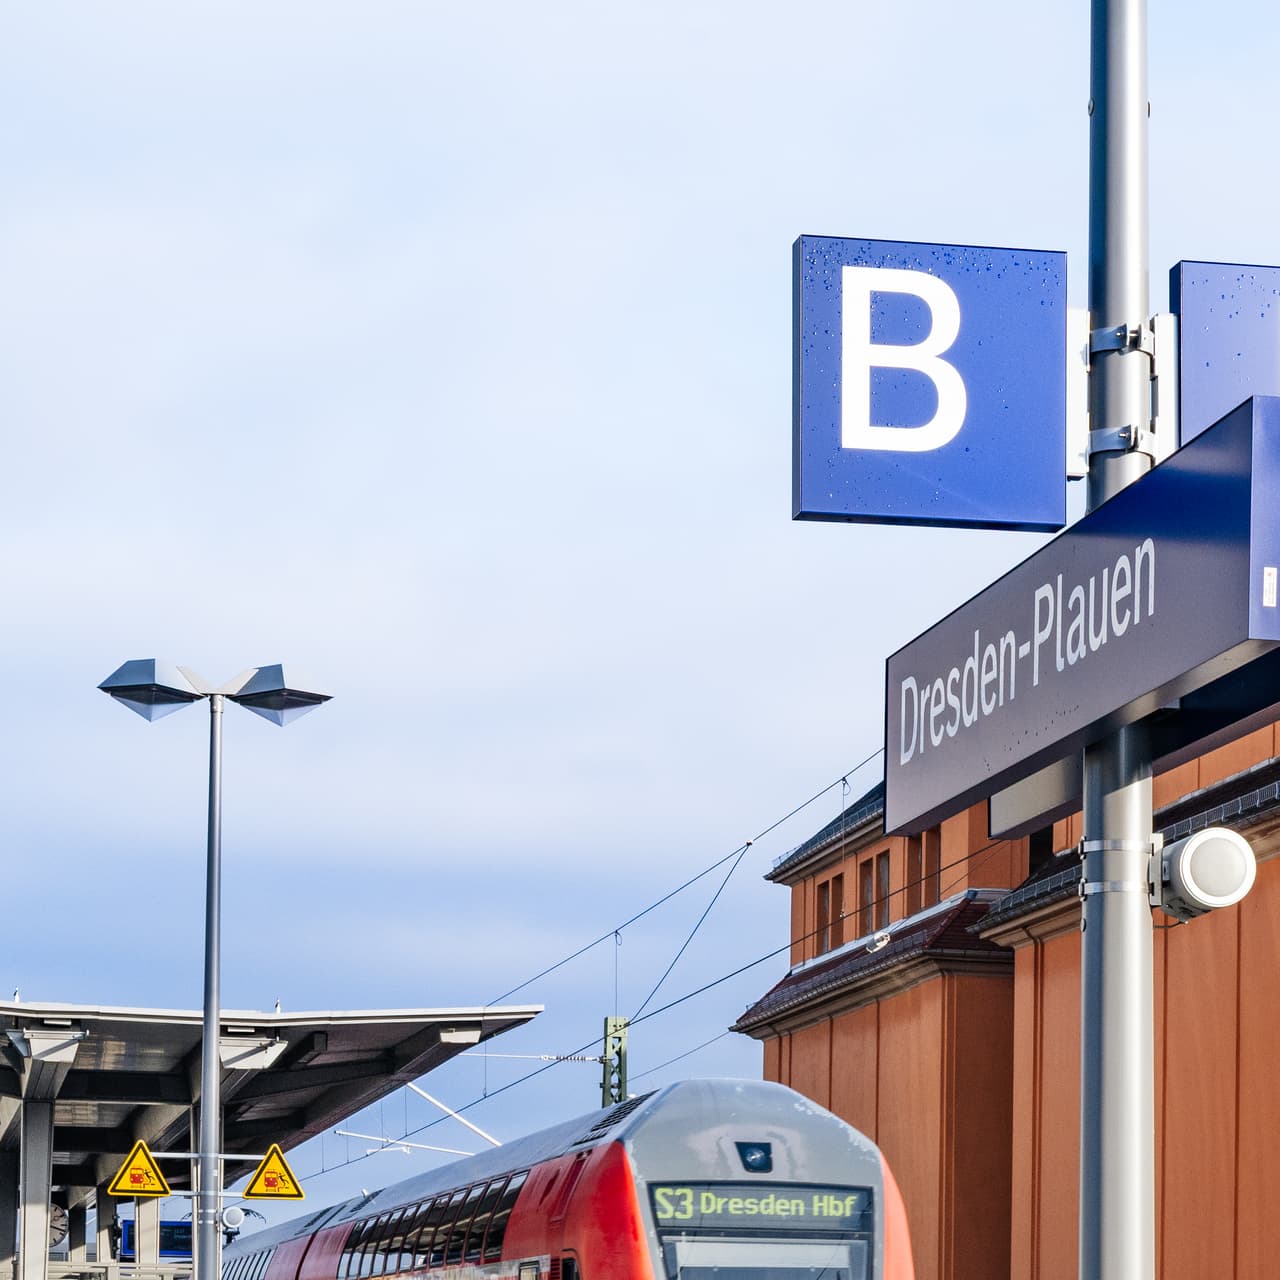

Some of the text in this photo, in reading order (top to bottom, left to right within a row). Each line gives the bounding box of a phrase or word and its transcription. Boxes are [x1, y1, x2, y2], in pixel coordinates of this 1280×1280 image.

[840, 265, 969, 453] B
[898, 537, 1159, 767] Dresden-Plauen
[654, 1187, 859, 1220] S3 Dresden Hbf
